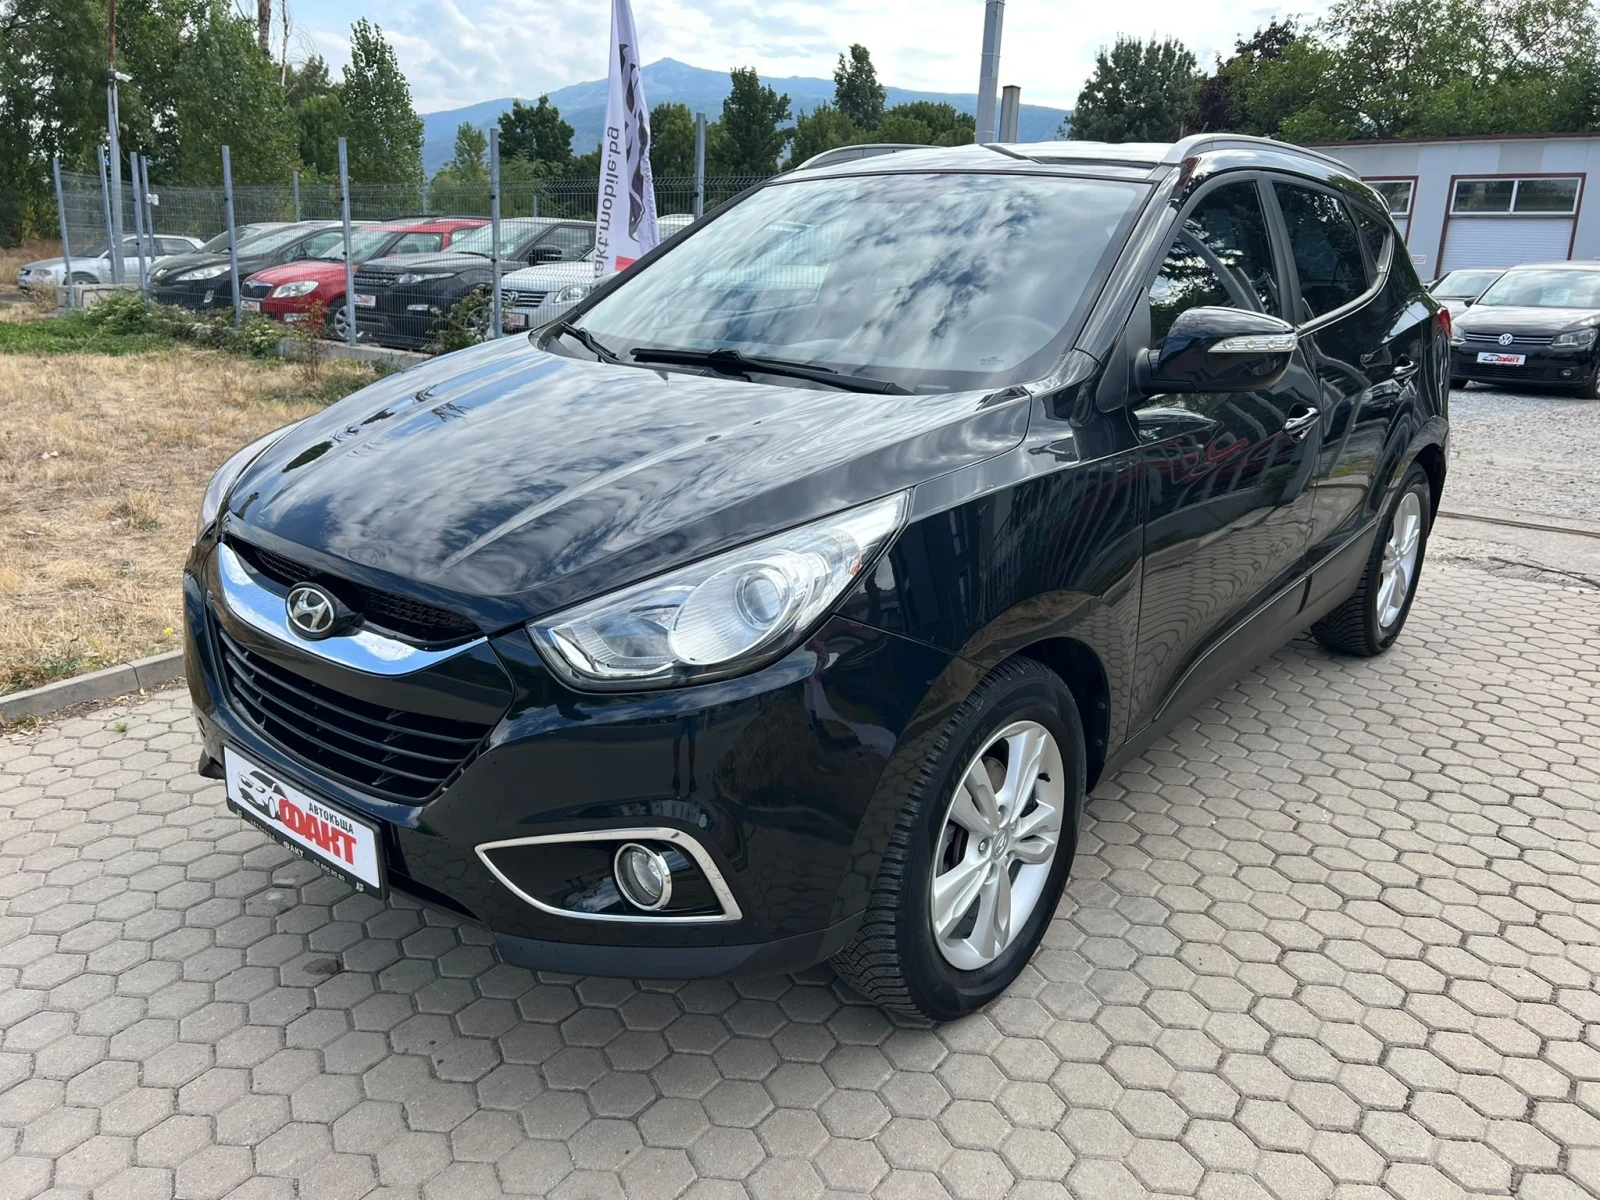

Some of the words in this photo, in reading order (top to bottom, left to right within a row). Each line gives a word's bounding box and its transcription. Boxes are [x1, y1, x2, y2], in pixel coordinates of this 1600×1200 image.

[279, 799, 357, 865] ФАКТ
[309, 803, 354, 834] АВТОКЪЩА
[283, 841, 305, 858] ФАКТ
